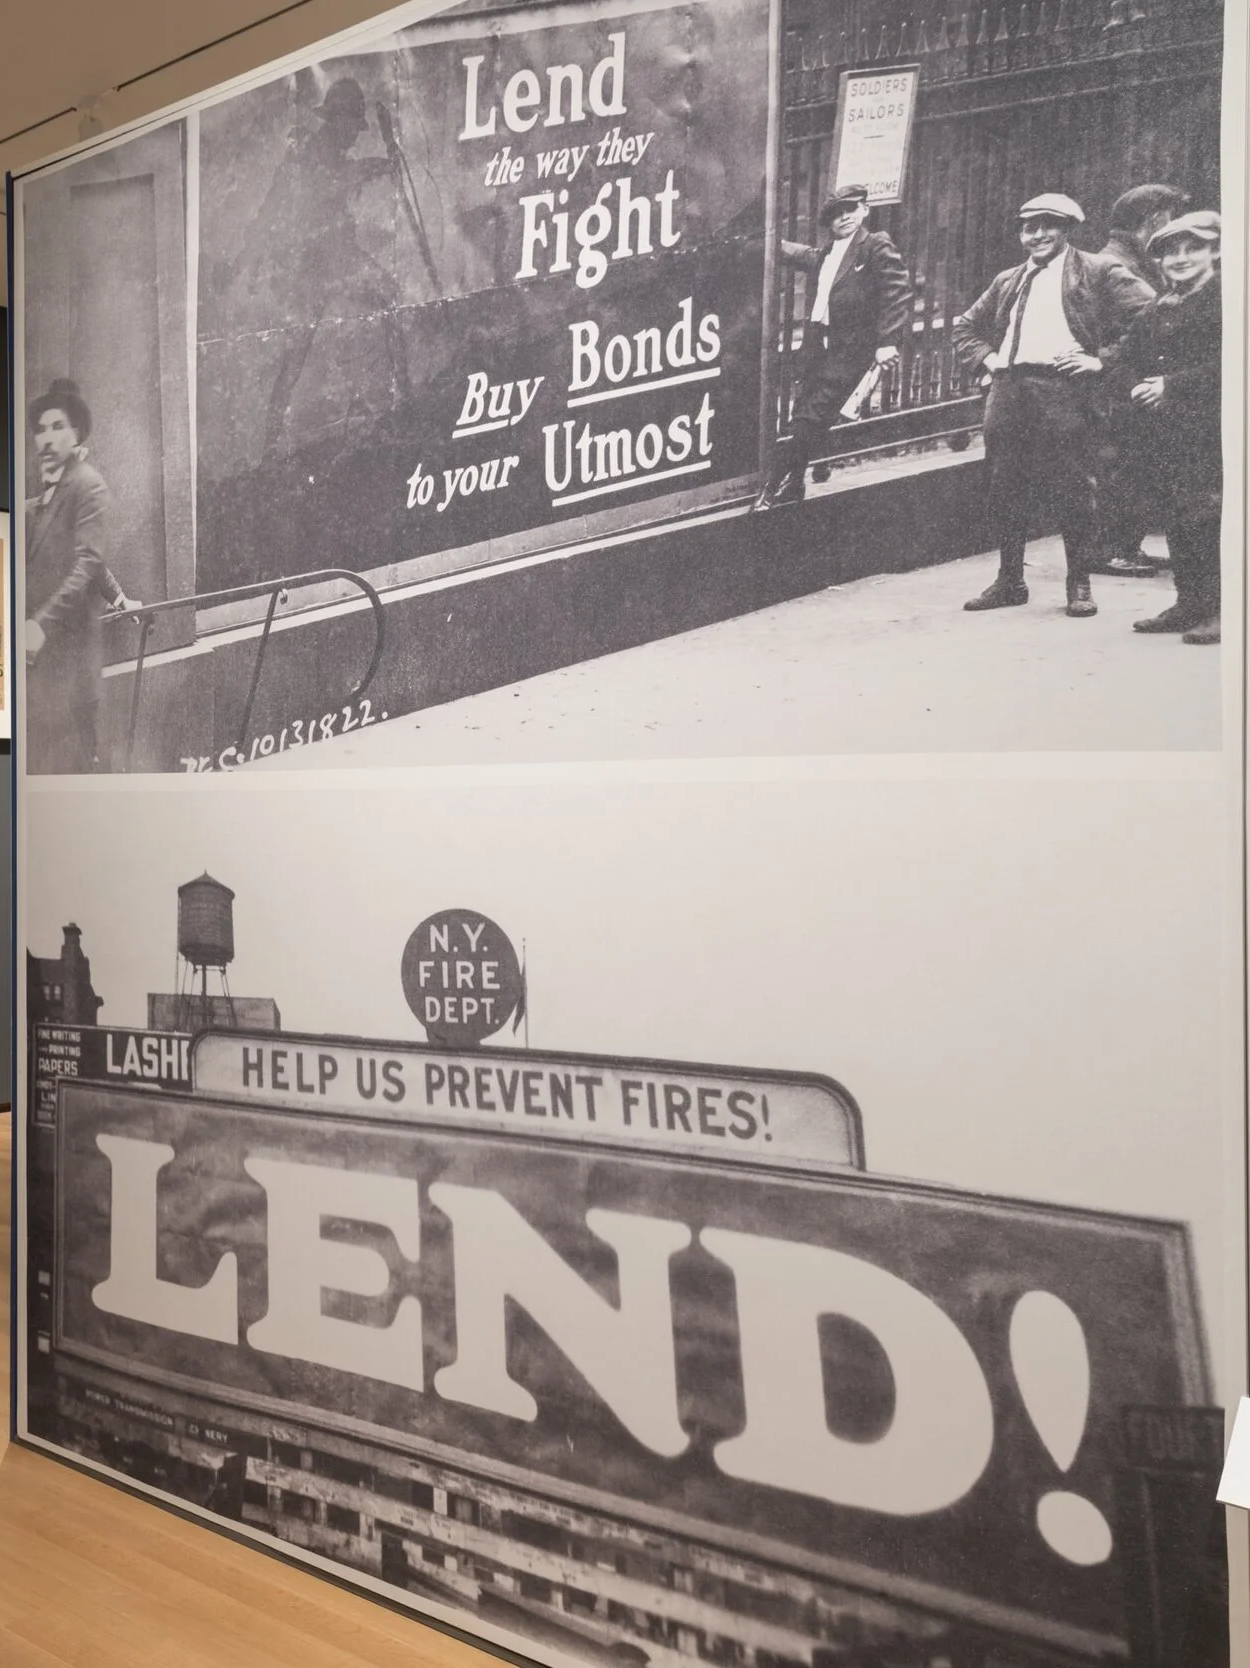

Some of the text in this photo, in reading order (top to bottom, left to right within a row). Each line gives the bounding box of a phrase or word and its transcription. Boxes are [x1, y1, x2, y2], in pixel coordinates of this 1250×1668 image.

[457, 32, 627, 141] Lend
[850, 77, 907, 97] SOLDIERS
[848, 103, 904, 122] SAILORS
[484, 127, 655, 187] the way they
[515, 170, 682, 289] Fight
[456, 297, 721, 427] Buy Bonds
[405, 393, 715, 512] to your Utmost
[428, 923, 488, 953] N.Y.
[419, 960, 501, 990] FIRE
[425, 996, 500, 1025] DEPT.
[51, 1030, 81, 1043] WRITING
[38, 1057, 78, 1076] PAPERS
[242, 1046, 773, 1142] HELP US PREVENT FIRES!
[91, 1131, 1114, 1567] LEND!
